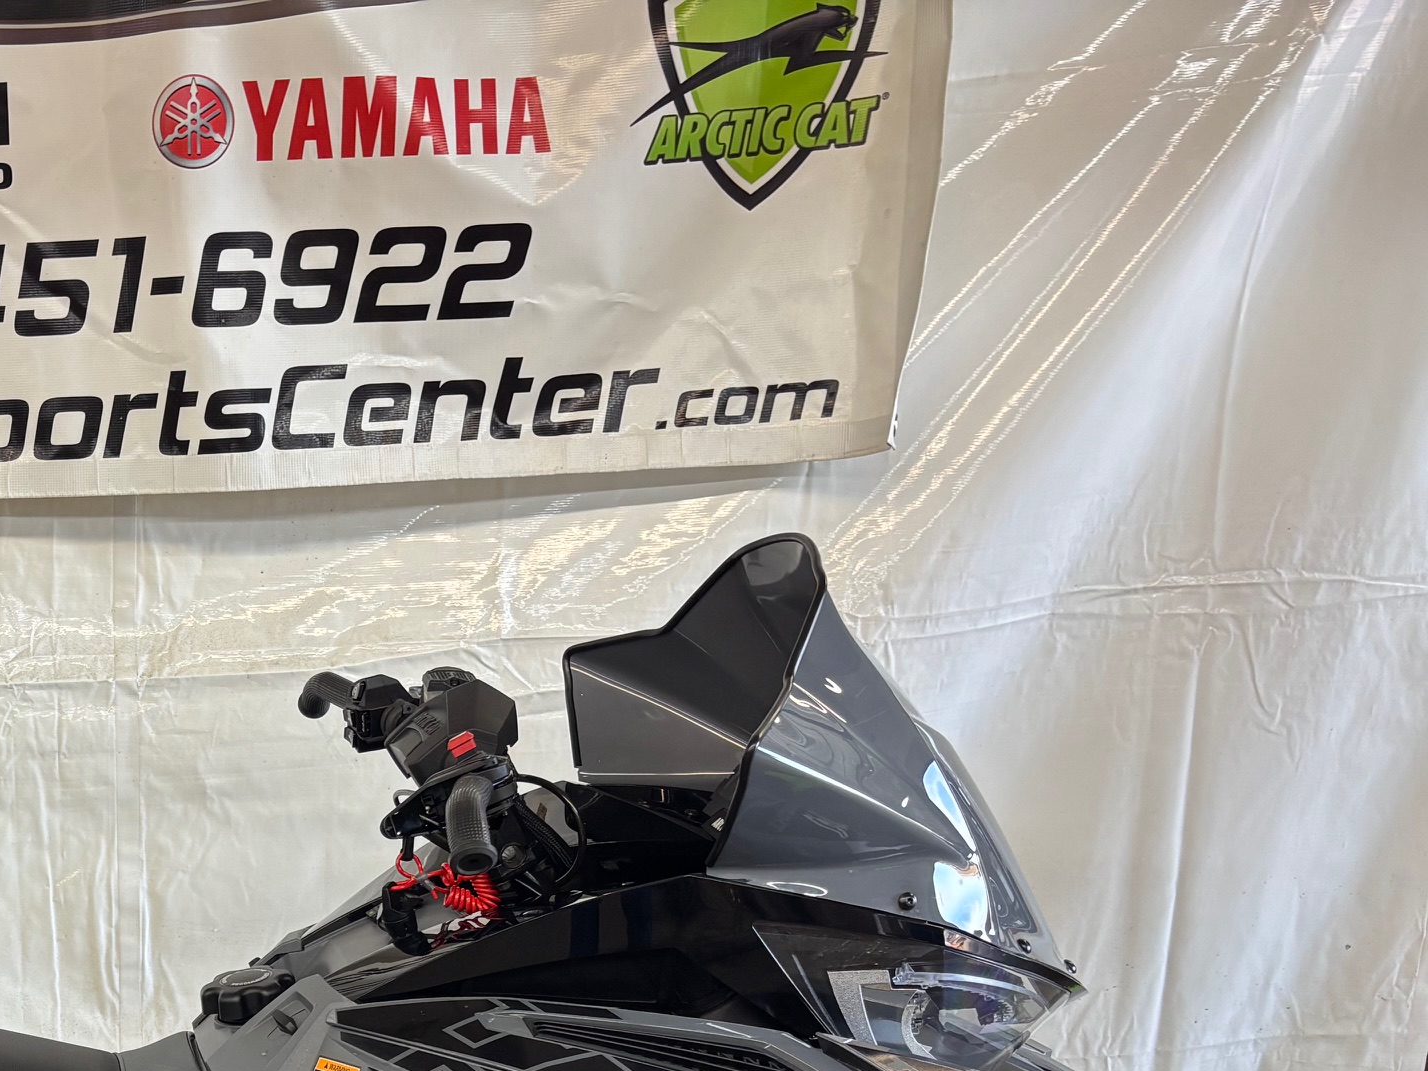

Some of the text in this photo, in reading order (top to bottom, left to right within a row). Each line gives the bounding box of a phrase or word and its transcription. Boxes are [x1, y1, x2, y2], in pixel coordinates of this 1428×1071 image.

[243, 74, 551, 163] YAMAHA
[645, 95, 881, 166] ARCTIC CAT
